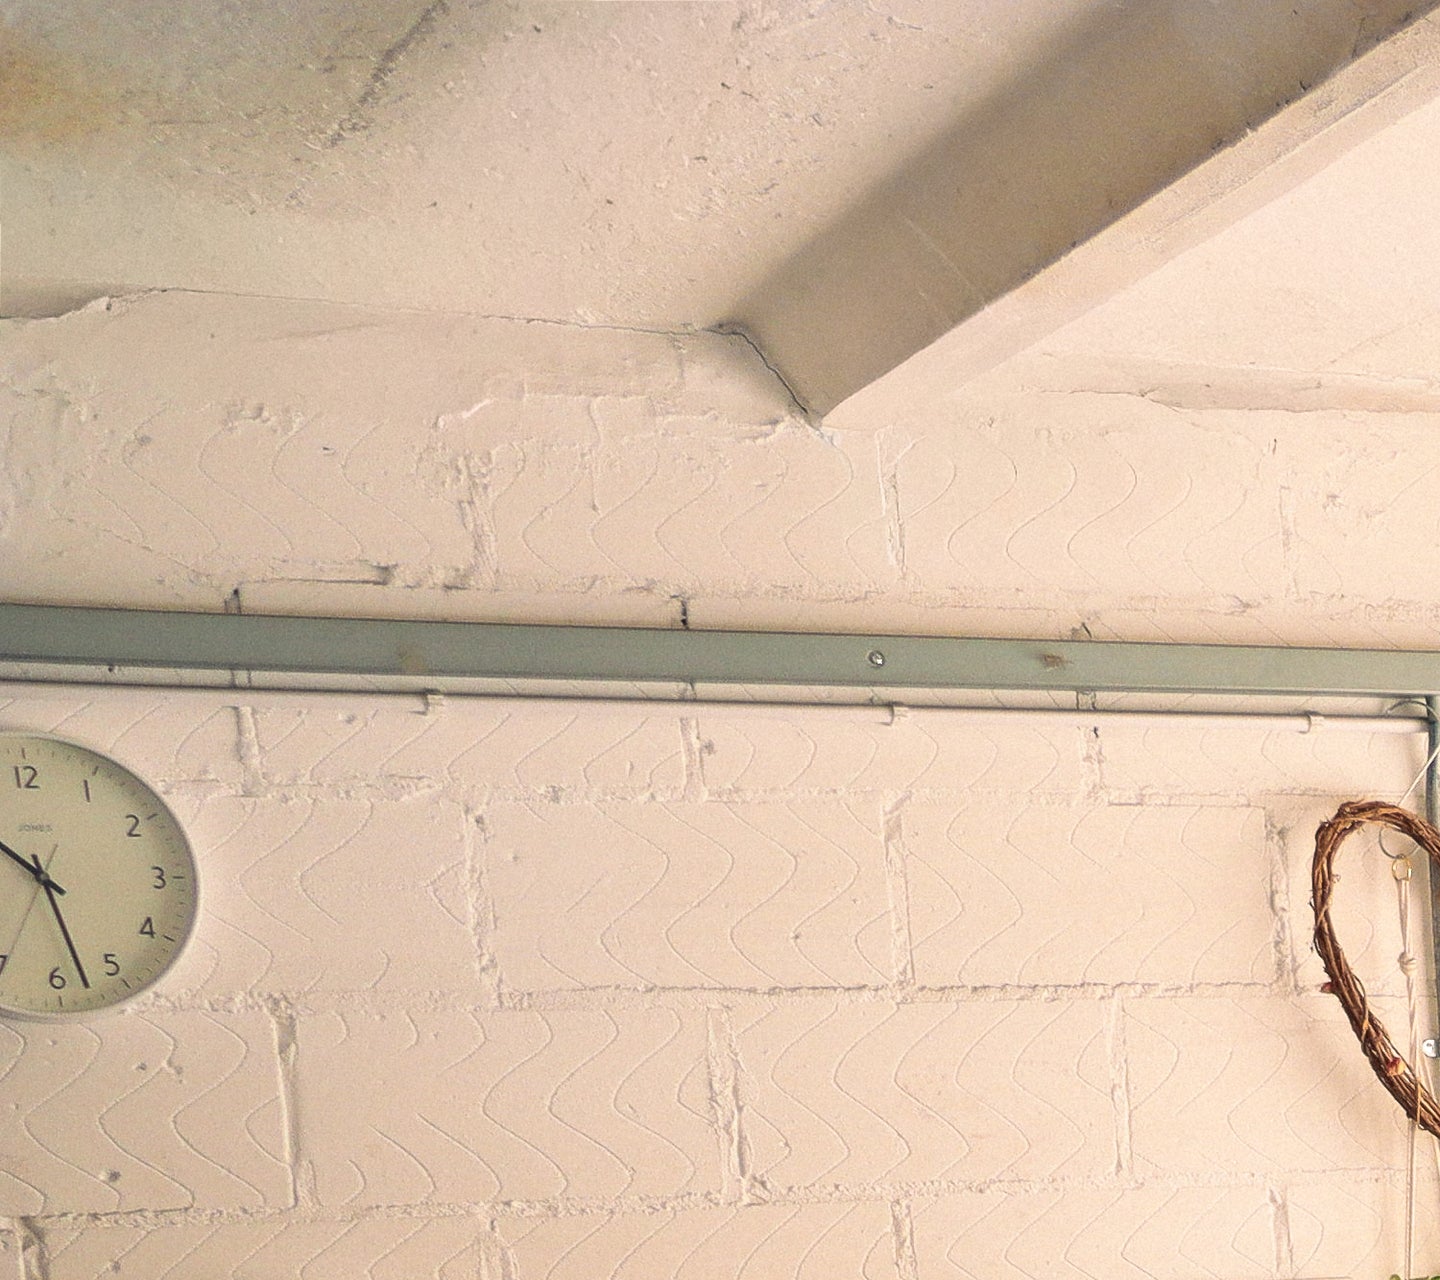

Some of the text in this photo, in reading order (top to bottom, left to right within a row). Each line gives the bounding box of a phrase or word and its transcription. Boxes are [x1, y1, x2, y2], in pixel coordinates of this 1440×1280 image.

[14, 766, 40, 789] 12
[83, 779, 91, 803] 1
[125, 815, 141, 838] 2
[151, 867, 166, 889] 3
[139, 916, 156, 939] 4
[103, 953, 120, 977] 5
[48, 966, 67, 990] 6
